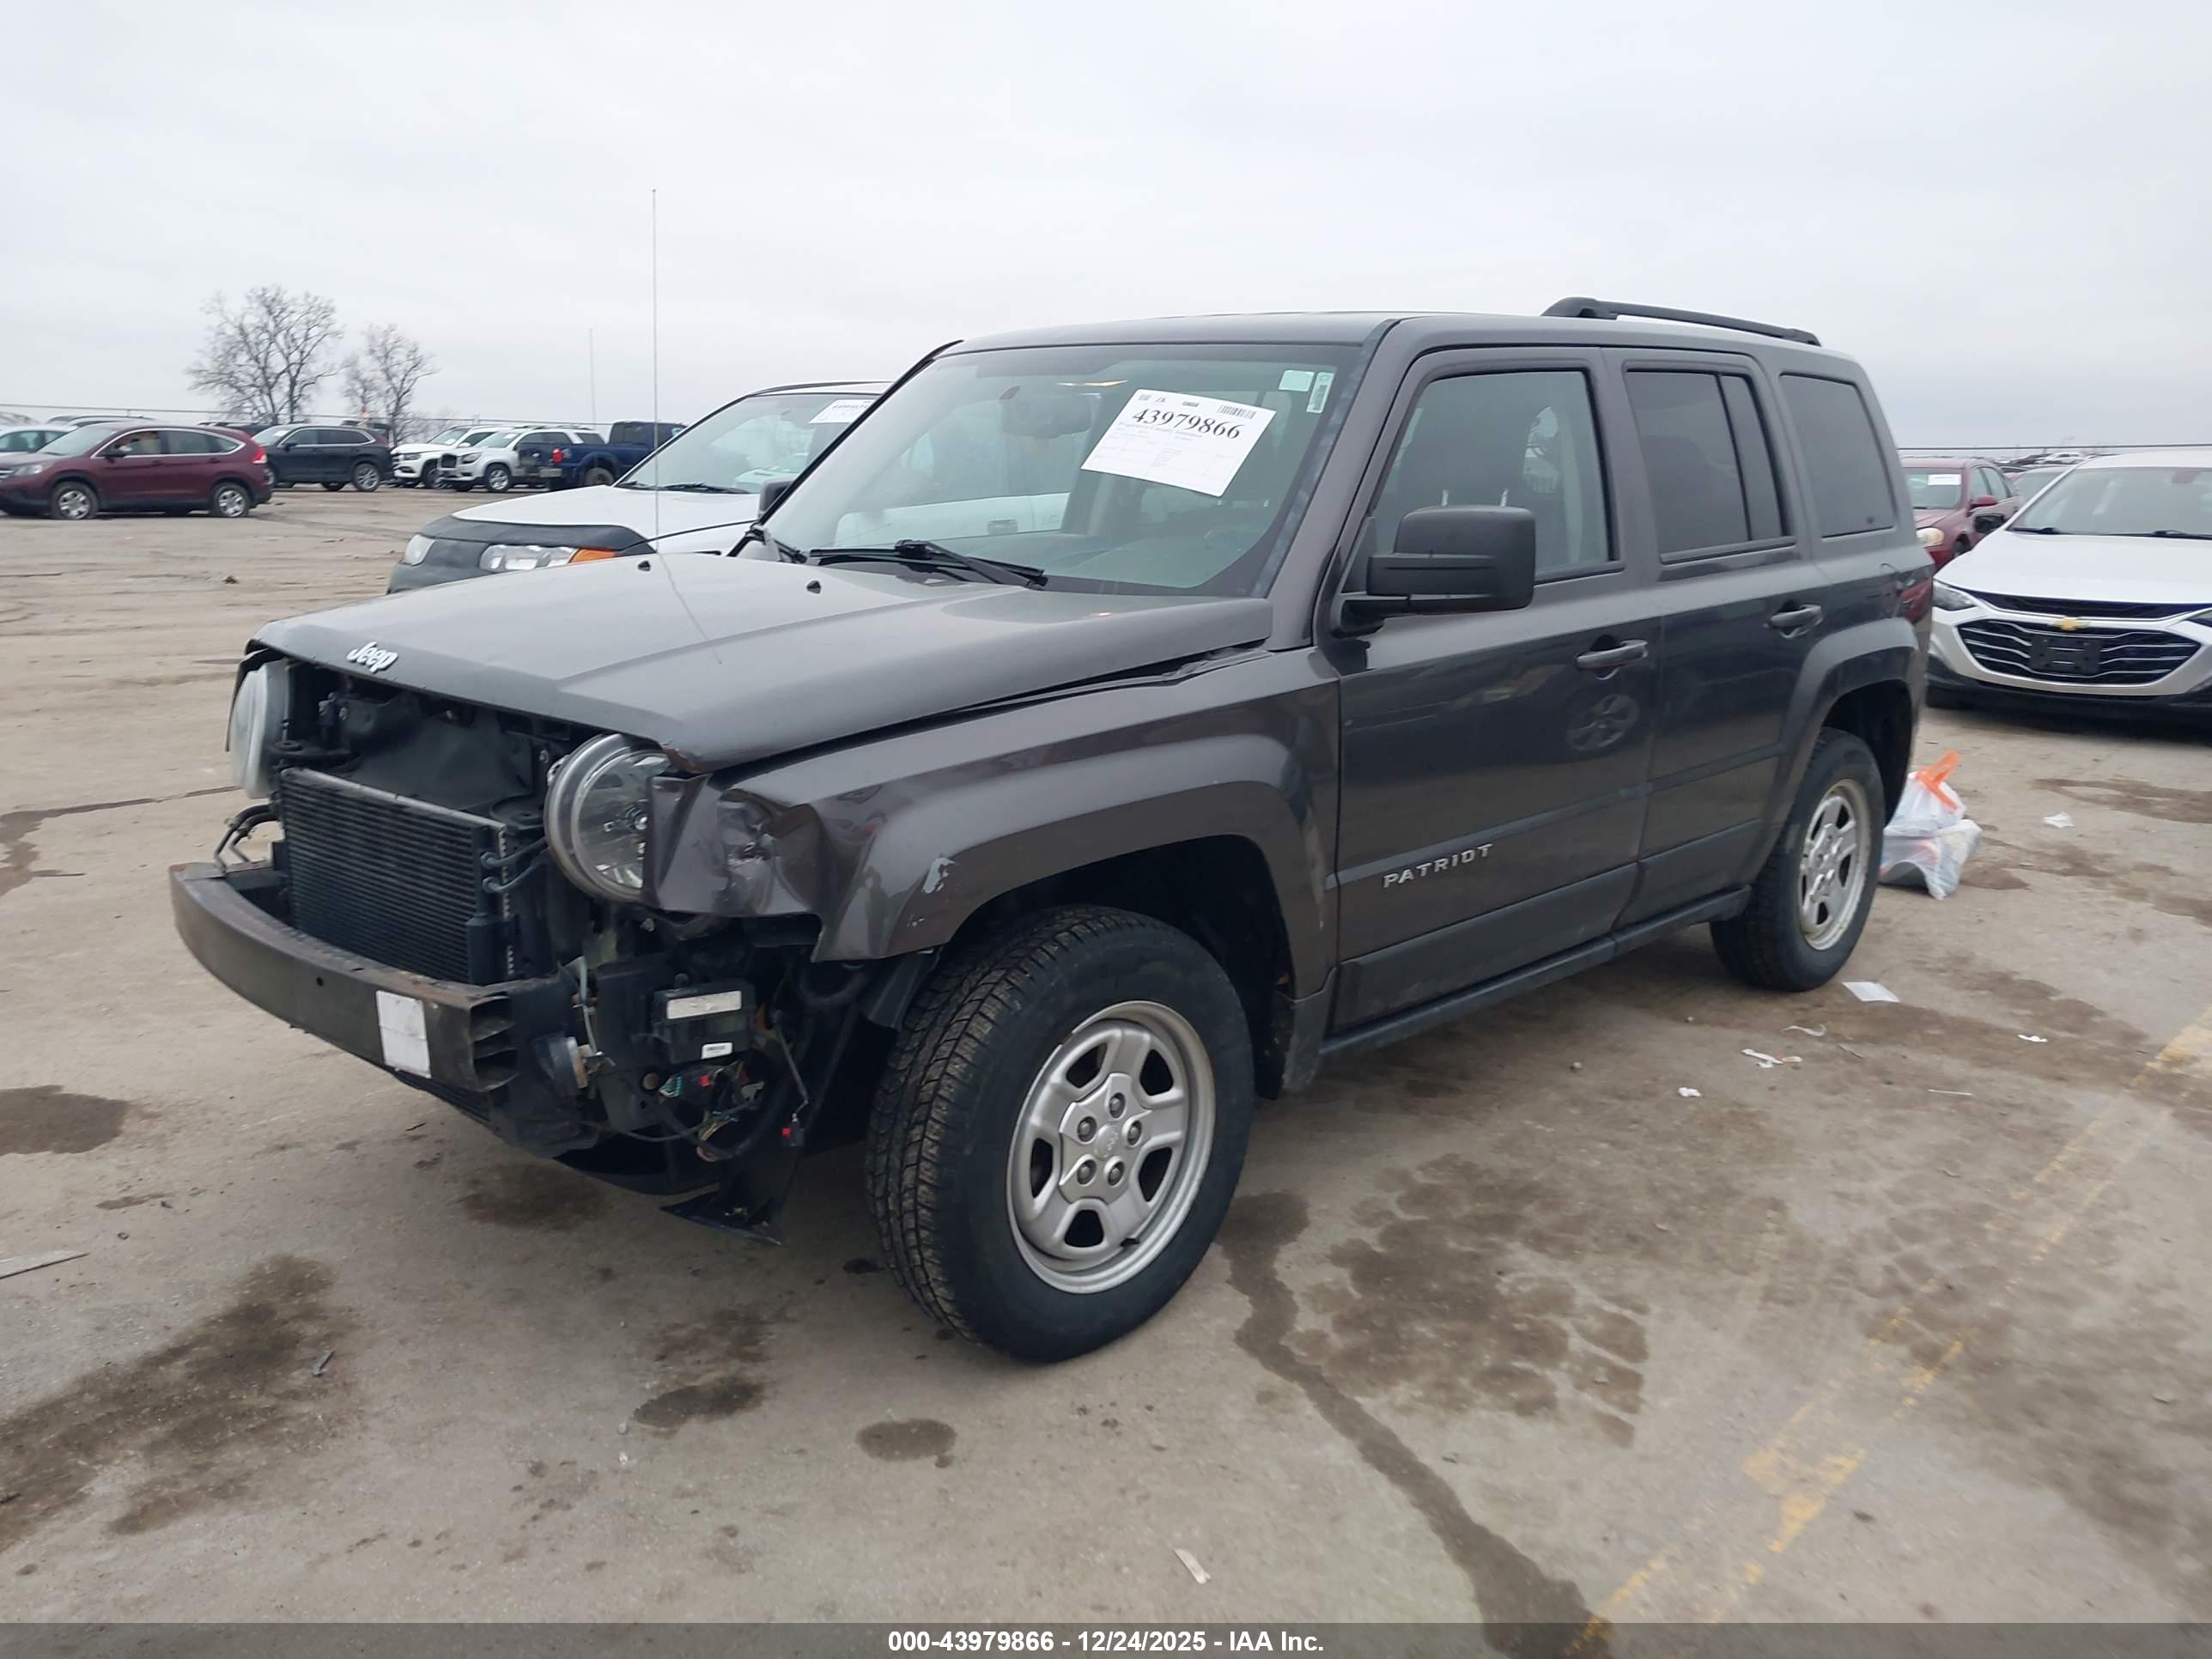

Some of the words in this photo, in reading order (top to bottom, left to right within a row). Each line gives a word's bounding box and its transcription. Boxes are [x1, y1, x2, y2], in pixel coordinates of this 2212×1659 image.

[1133, 408, 1245, 440] 43979866
[345, 641, 398, 674] Jeep
[1382, 843, 1493, 888] PATRIOT
